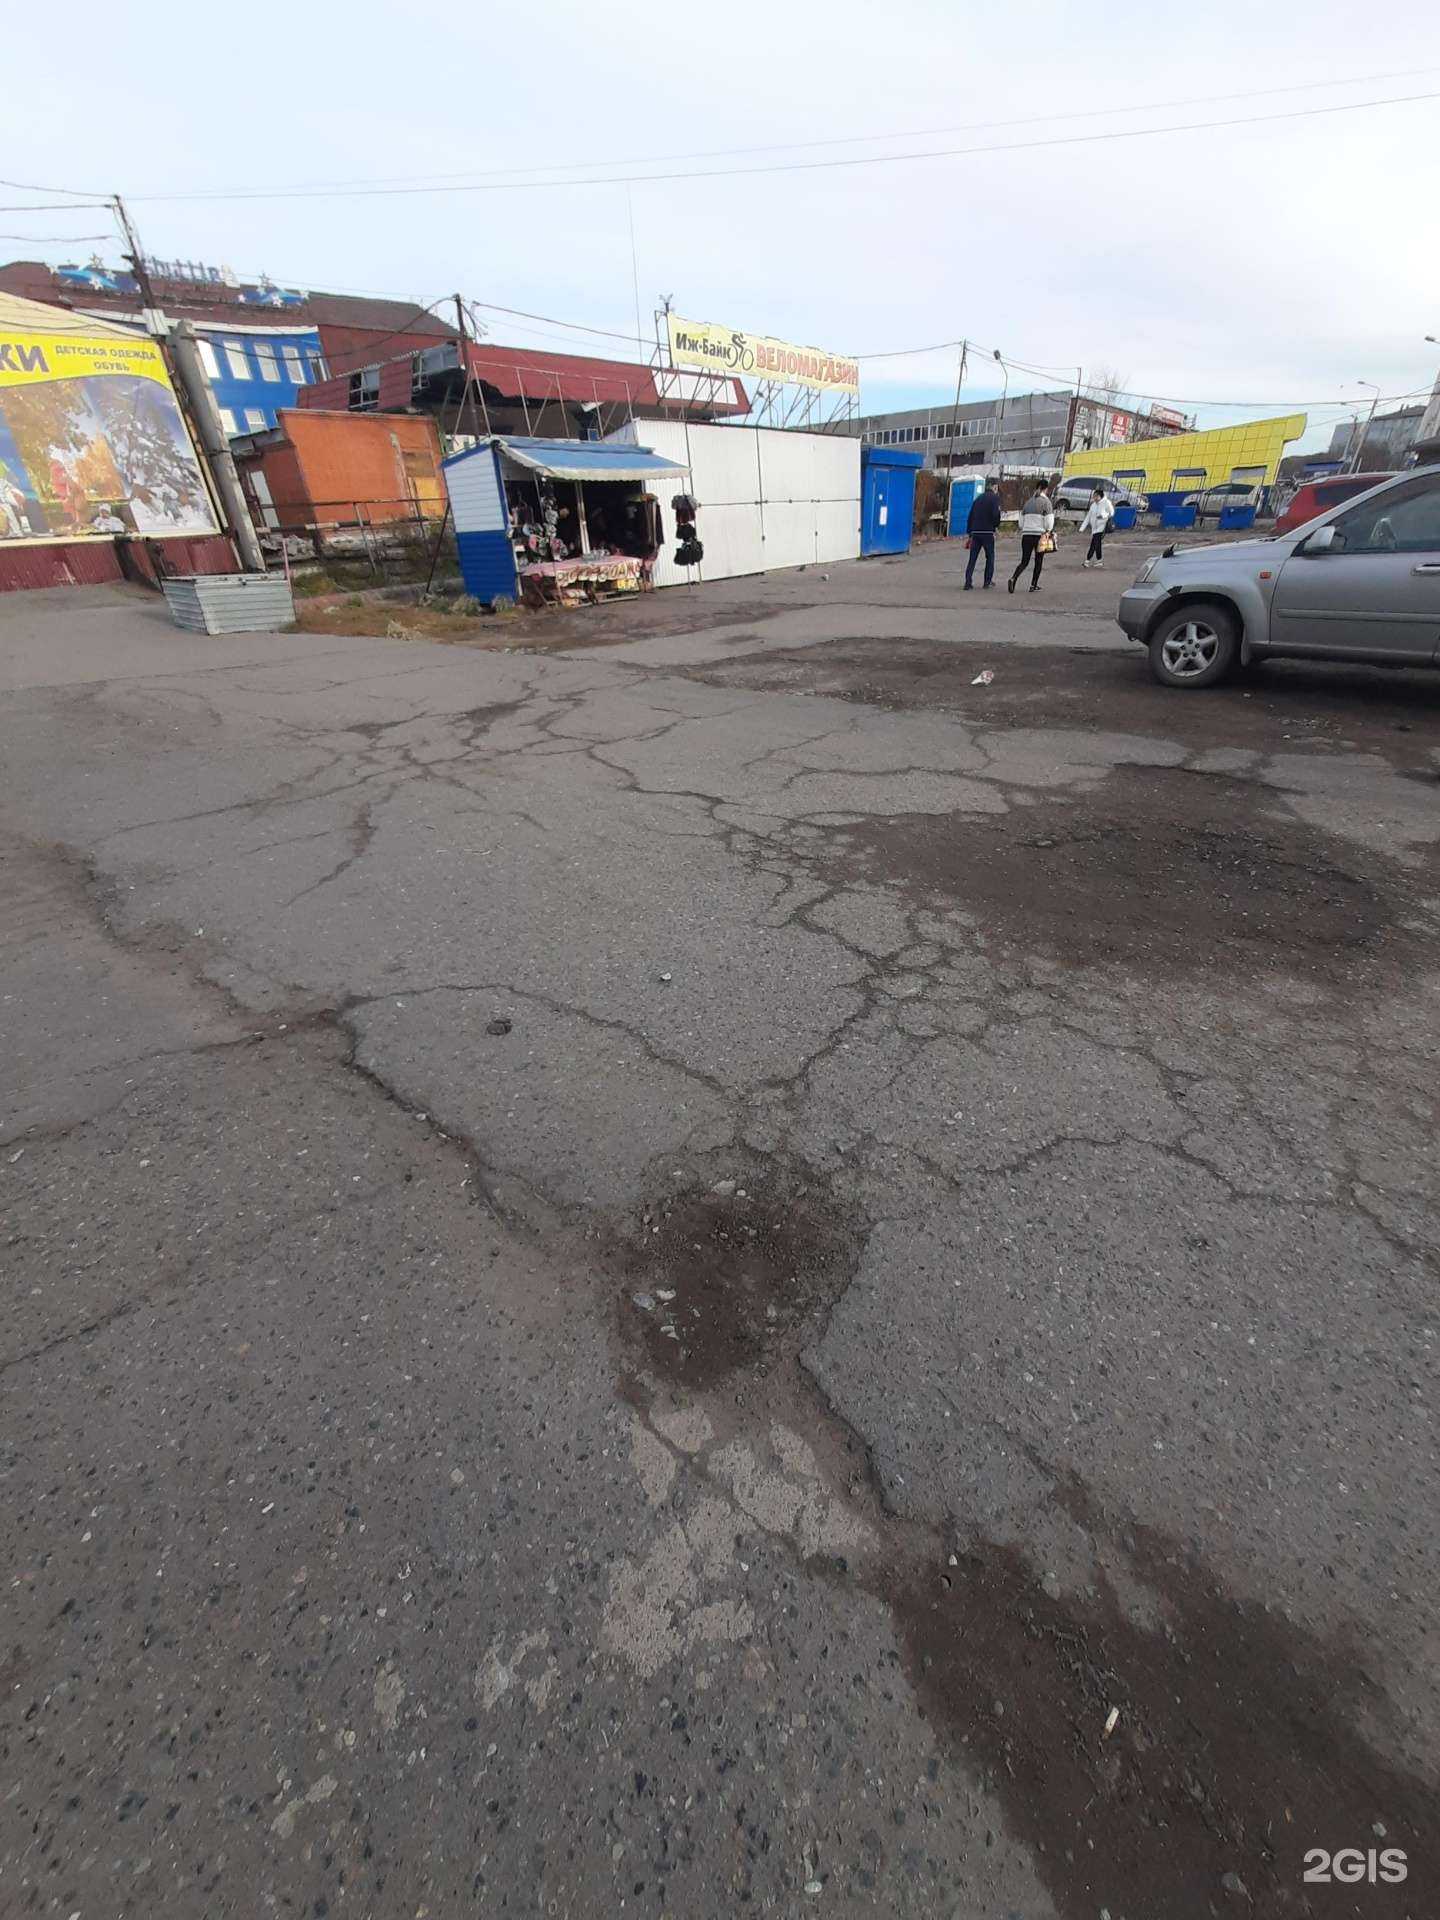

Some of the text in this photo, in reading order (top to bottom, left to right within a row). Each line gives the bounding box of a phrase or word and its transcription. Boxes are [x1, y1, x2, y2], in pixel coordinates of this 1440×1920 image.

[55, 345, 157, 360] ДЕТСКАЯ ОДЕЖДА
[675, 332, 732, 360] Иж-Байк
[93, 361, 130, 372] ОБУВЬ
[756, 343, 860, 386] ВЕЛОМАГАЗИН
